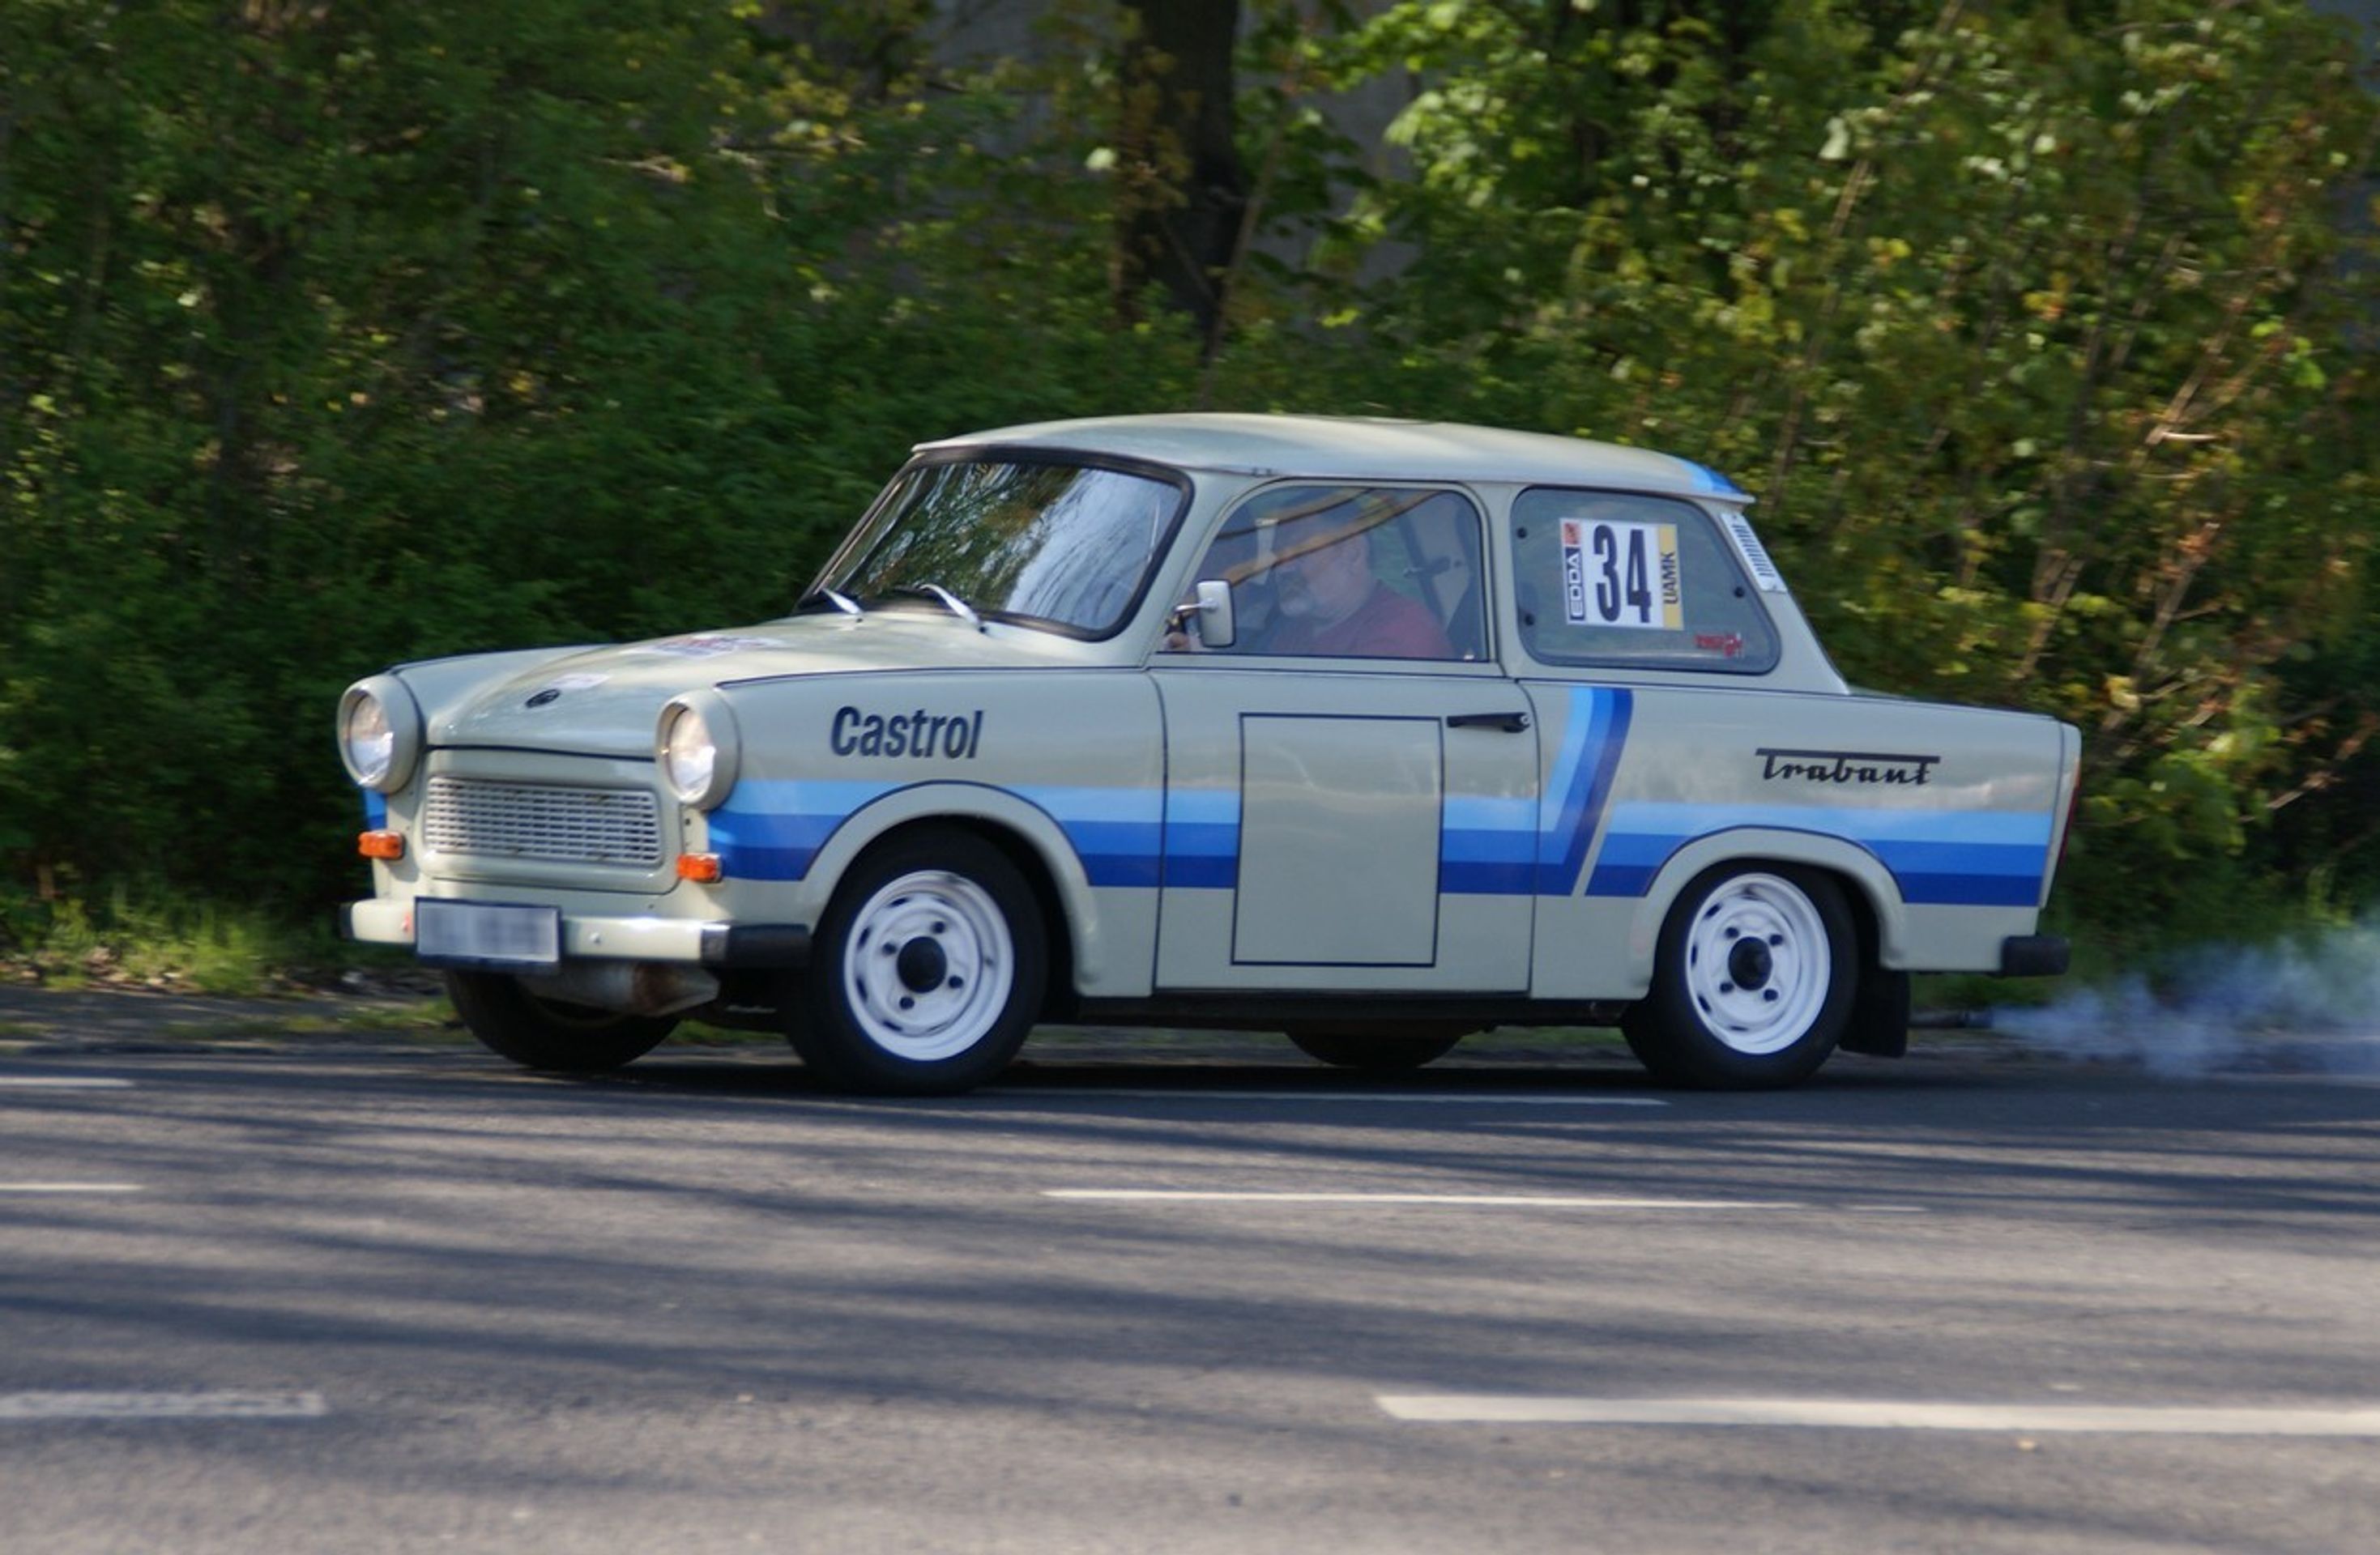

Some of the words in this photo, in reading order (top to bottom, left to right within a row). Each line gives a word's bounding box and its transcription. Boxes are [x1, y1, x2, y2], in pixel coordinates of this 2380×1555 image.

[1593, 524, 1652, 623] 34
[830, 706, 984, 759] Castrol
[1755, 748, 1940, 785] Trabant
